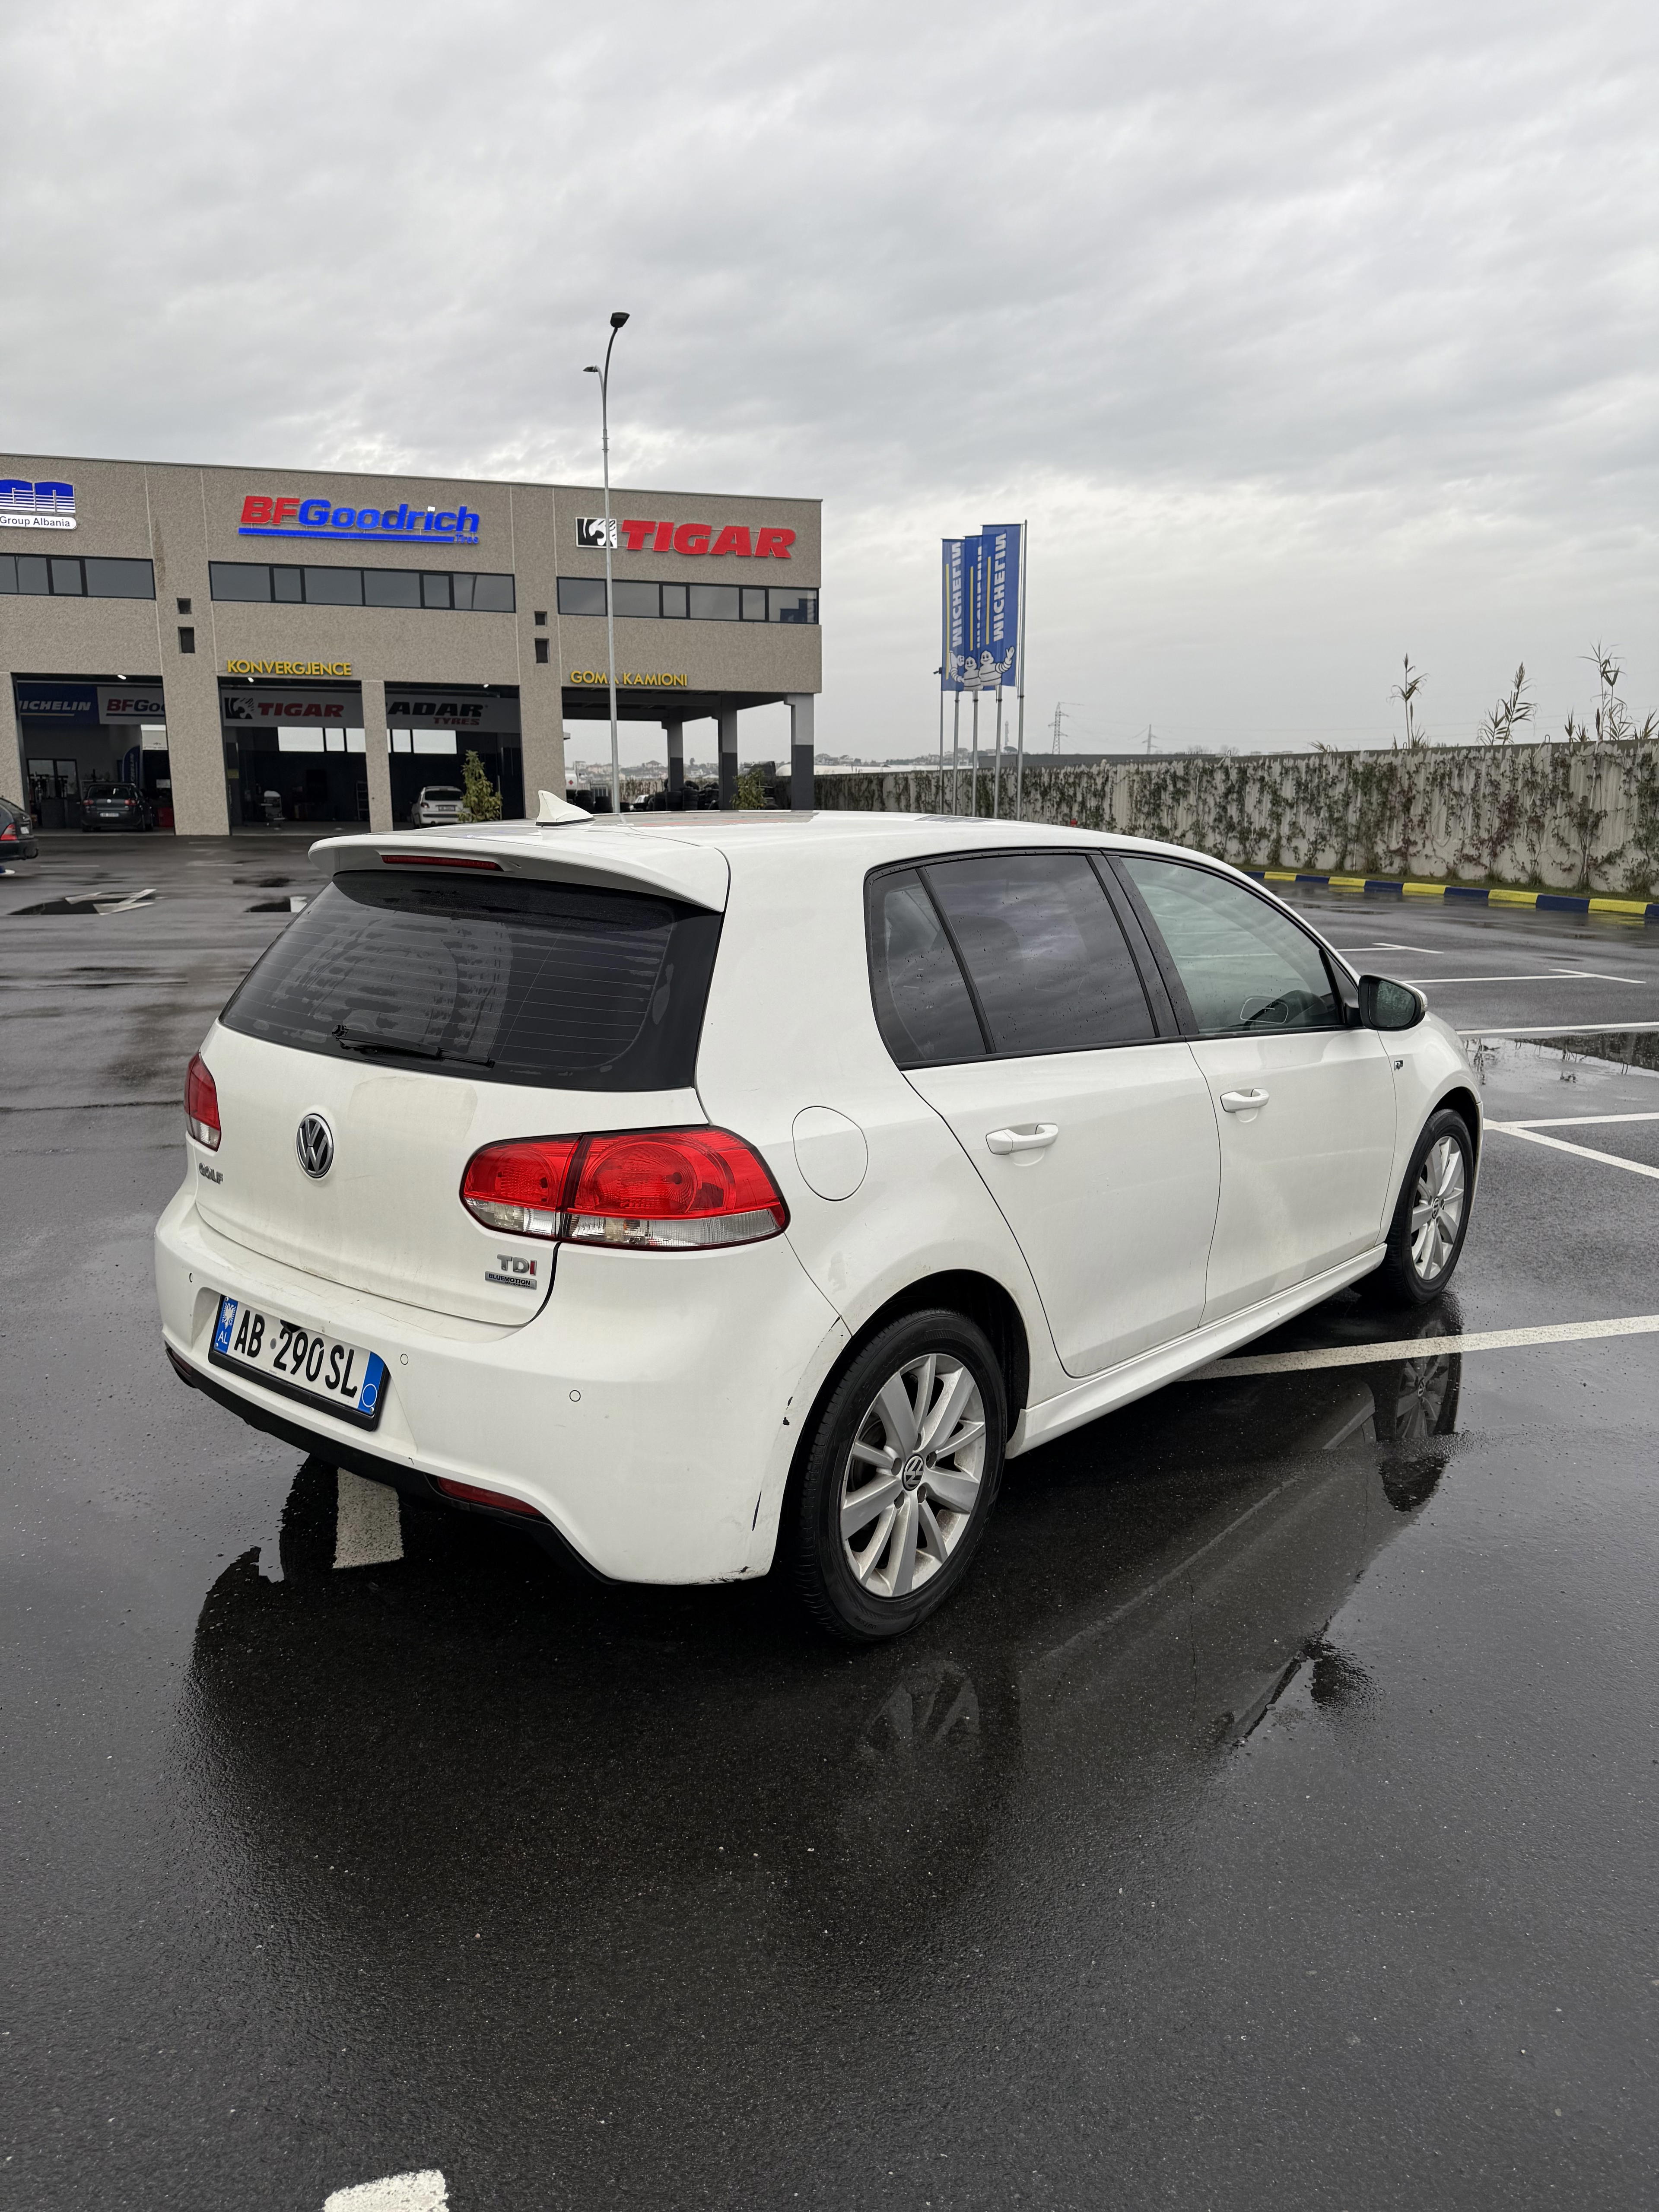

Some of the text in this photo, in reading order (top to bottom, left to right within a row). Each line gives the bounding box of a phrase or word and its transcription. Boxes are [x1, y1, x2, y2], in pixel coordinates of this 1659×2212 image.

[0, 516, 70, 527] Group Albania
[240, 496, 480, 533] BFGoodrich
[621, 520, 796, 559] TIGAR
[227, 660, 352, 676] KONVERGJENCE
[623, 672, 687, 686] KAMIONI
[19, 700, 92, 711] ICHELIN
[107, 699, 165, 712] BFGo
[258, 702, 344, 717] TIGAR
[386, 702, 483, 717] ADAR
[434, 717, 480, 726] TYRES
[199, 1162, 223, 1185] GOLF
[497, 1254, 537, 1276] TDI
[489, 1273, 531, 1285] BLUEMOTION
[218, 1330, 229, 1345] AL
[234, 1309, 265, 1358] AB
